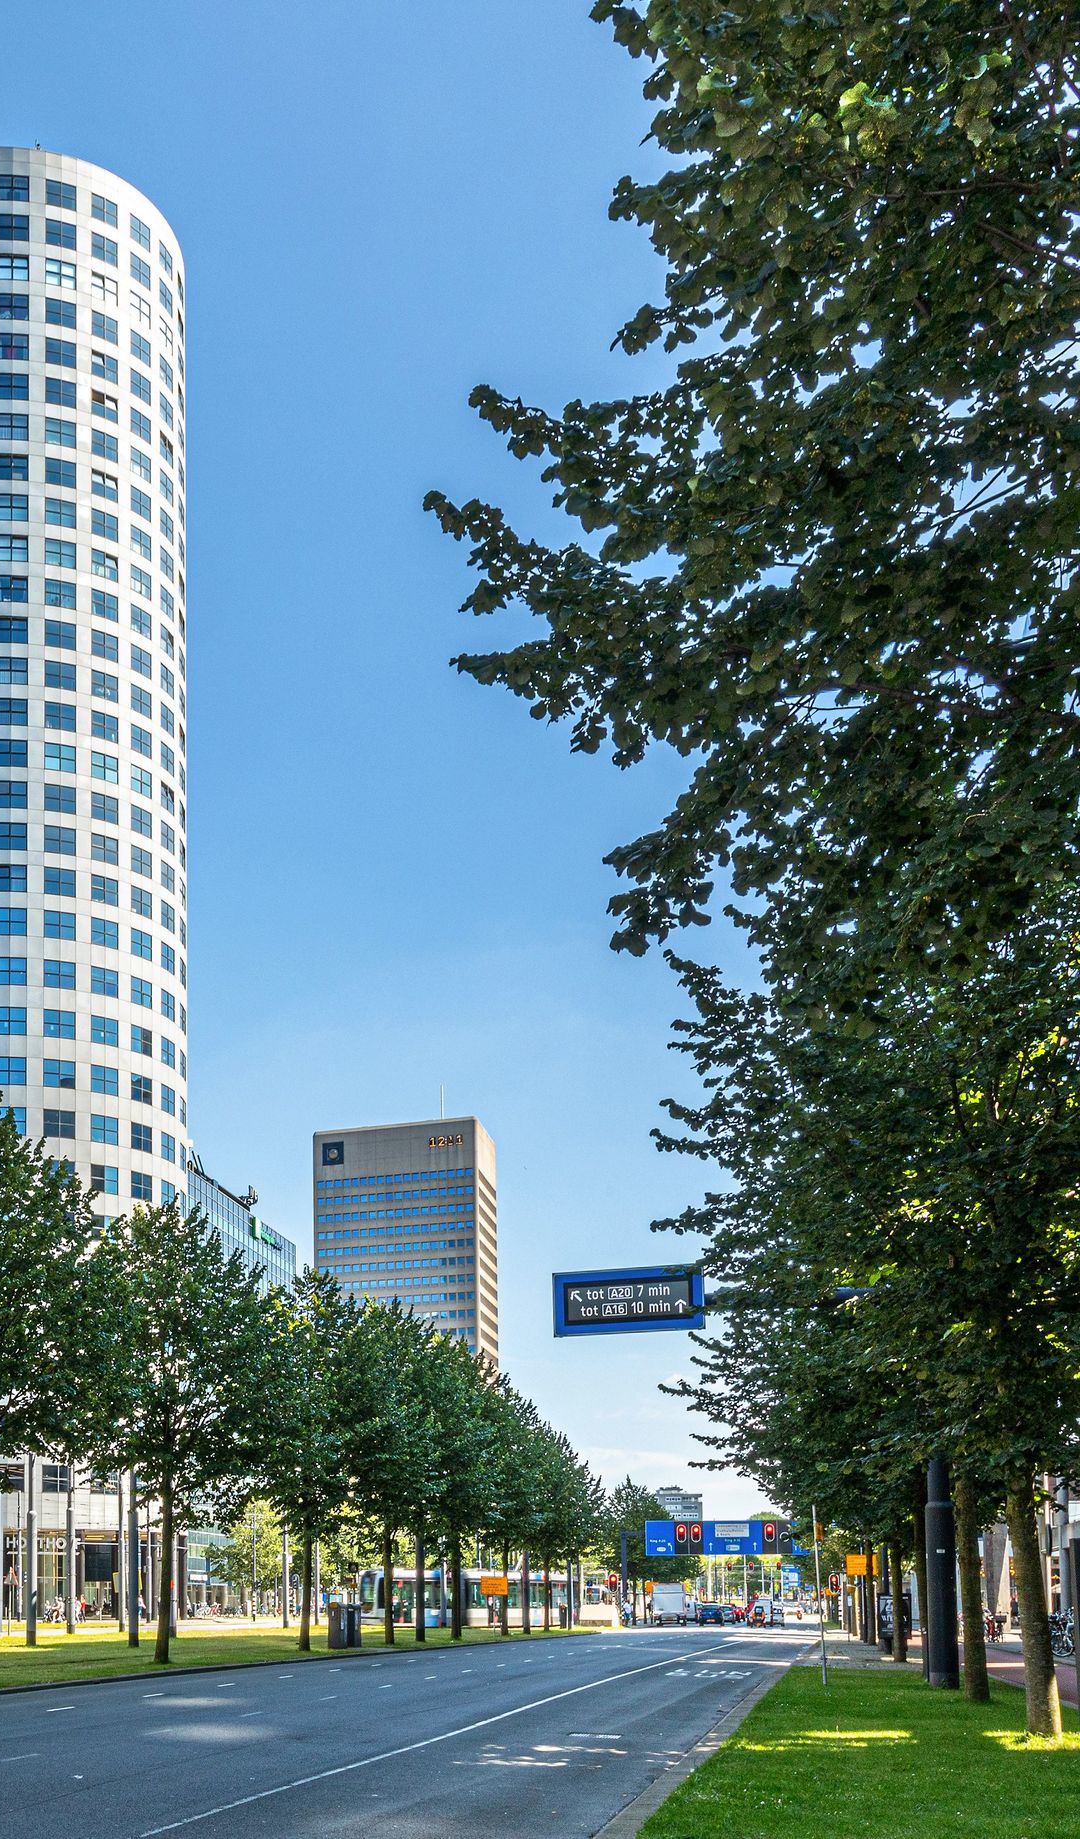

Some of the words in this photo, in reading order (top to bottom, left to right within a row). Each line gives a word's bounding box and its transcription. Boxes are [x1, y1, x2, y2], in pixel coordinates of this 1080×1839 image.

[586, 1288, 604, 1300] tot
[610, 1287, 631, 1298] A20
[636, 1285, 644, 1297] 7
[648, 1283, 670, 1296] min
[580, 1305, 598, 1317] tot
[605, 1304, 625, 1315] A16
[631, 1301, 644, 1314] 10
[649, 1300, 670, 1312] min
